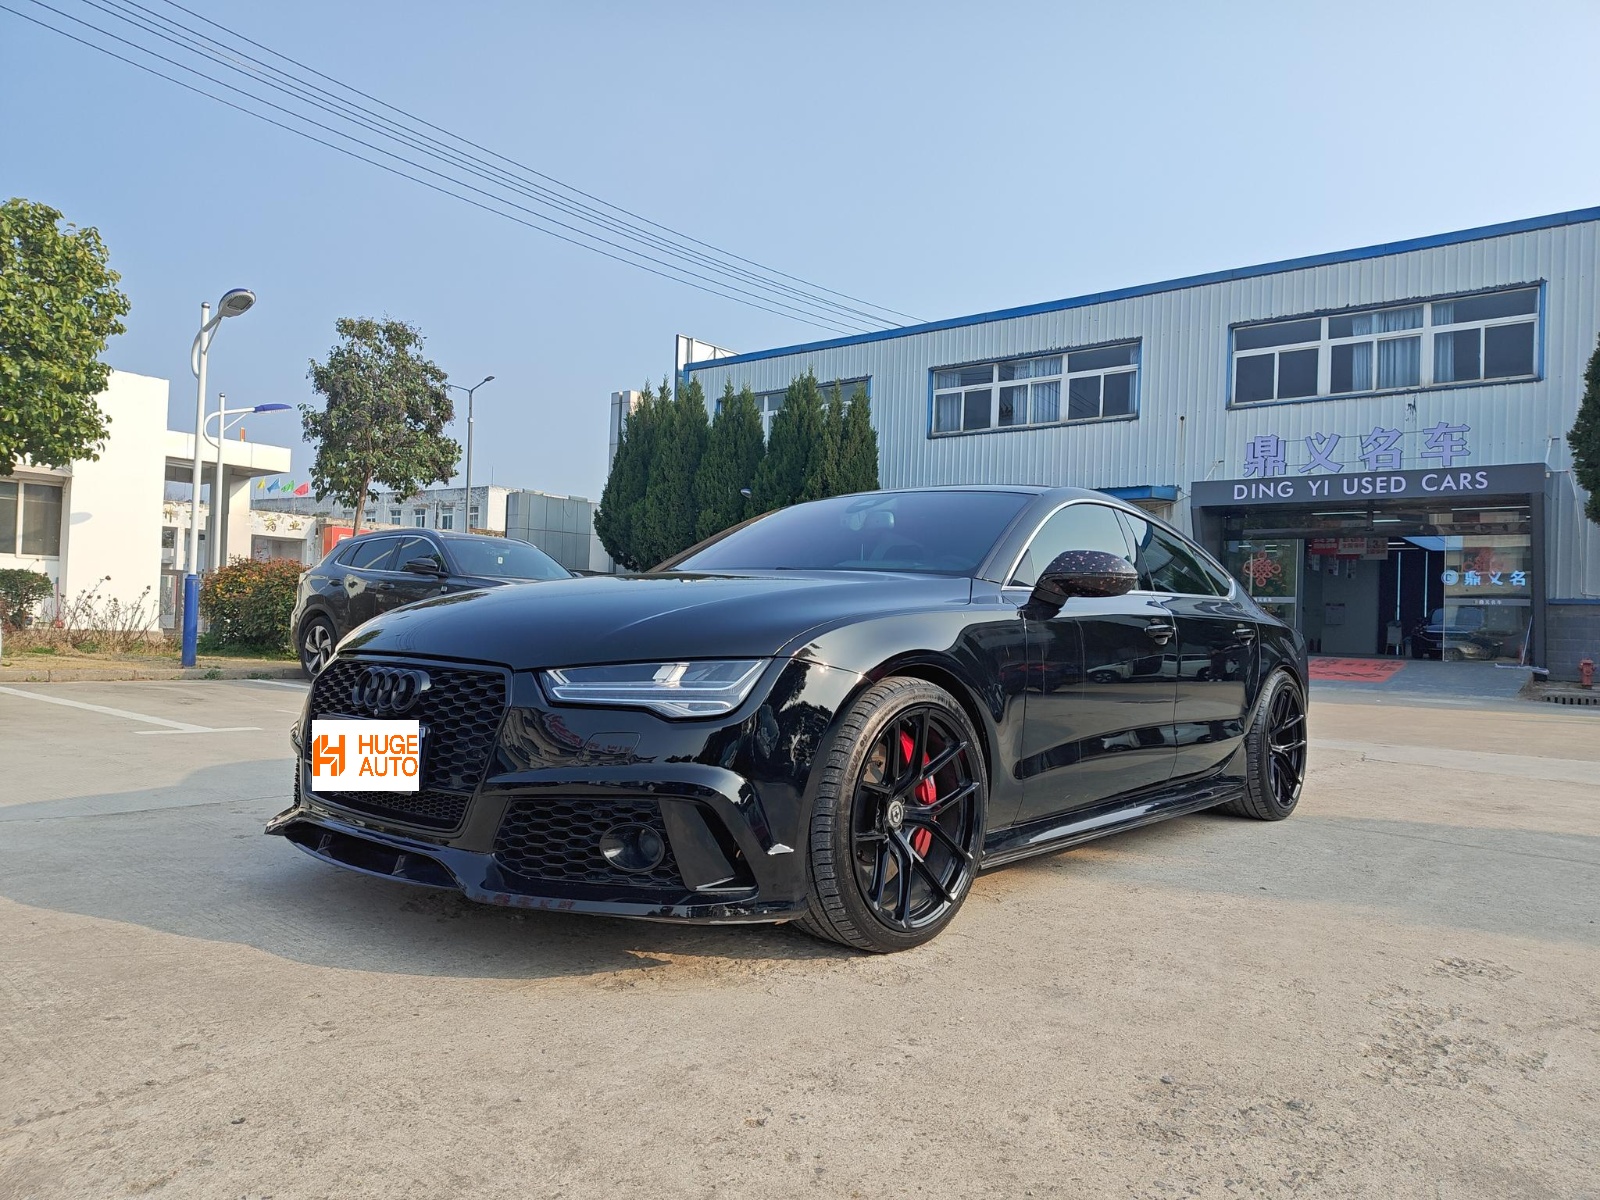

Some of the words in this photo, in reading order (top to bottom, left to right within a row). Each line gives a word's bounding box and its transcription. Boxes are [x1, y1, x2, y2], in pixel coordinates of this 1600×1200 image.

[1243, 421, 1472, 477] 鼎义名车
[1233, 481, 1294, 500] DING
[1307, 480, 1330, 496] YI
[1342, 476, 1407, 495] USED
[1420, 471, 1489, 491] CARS
